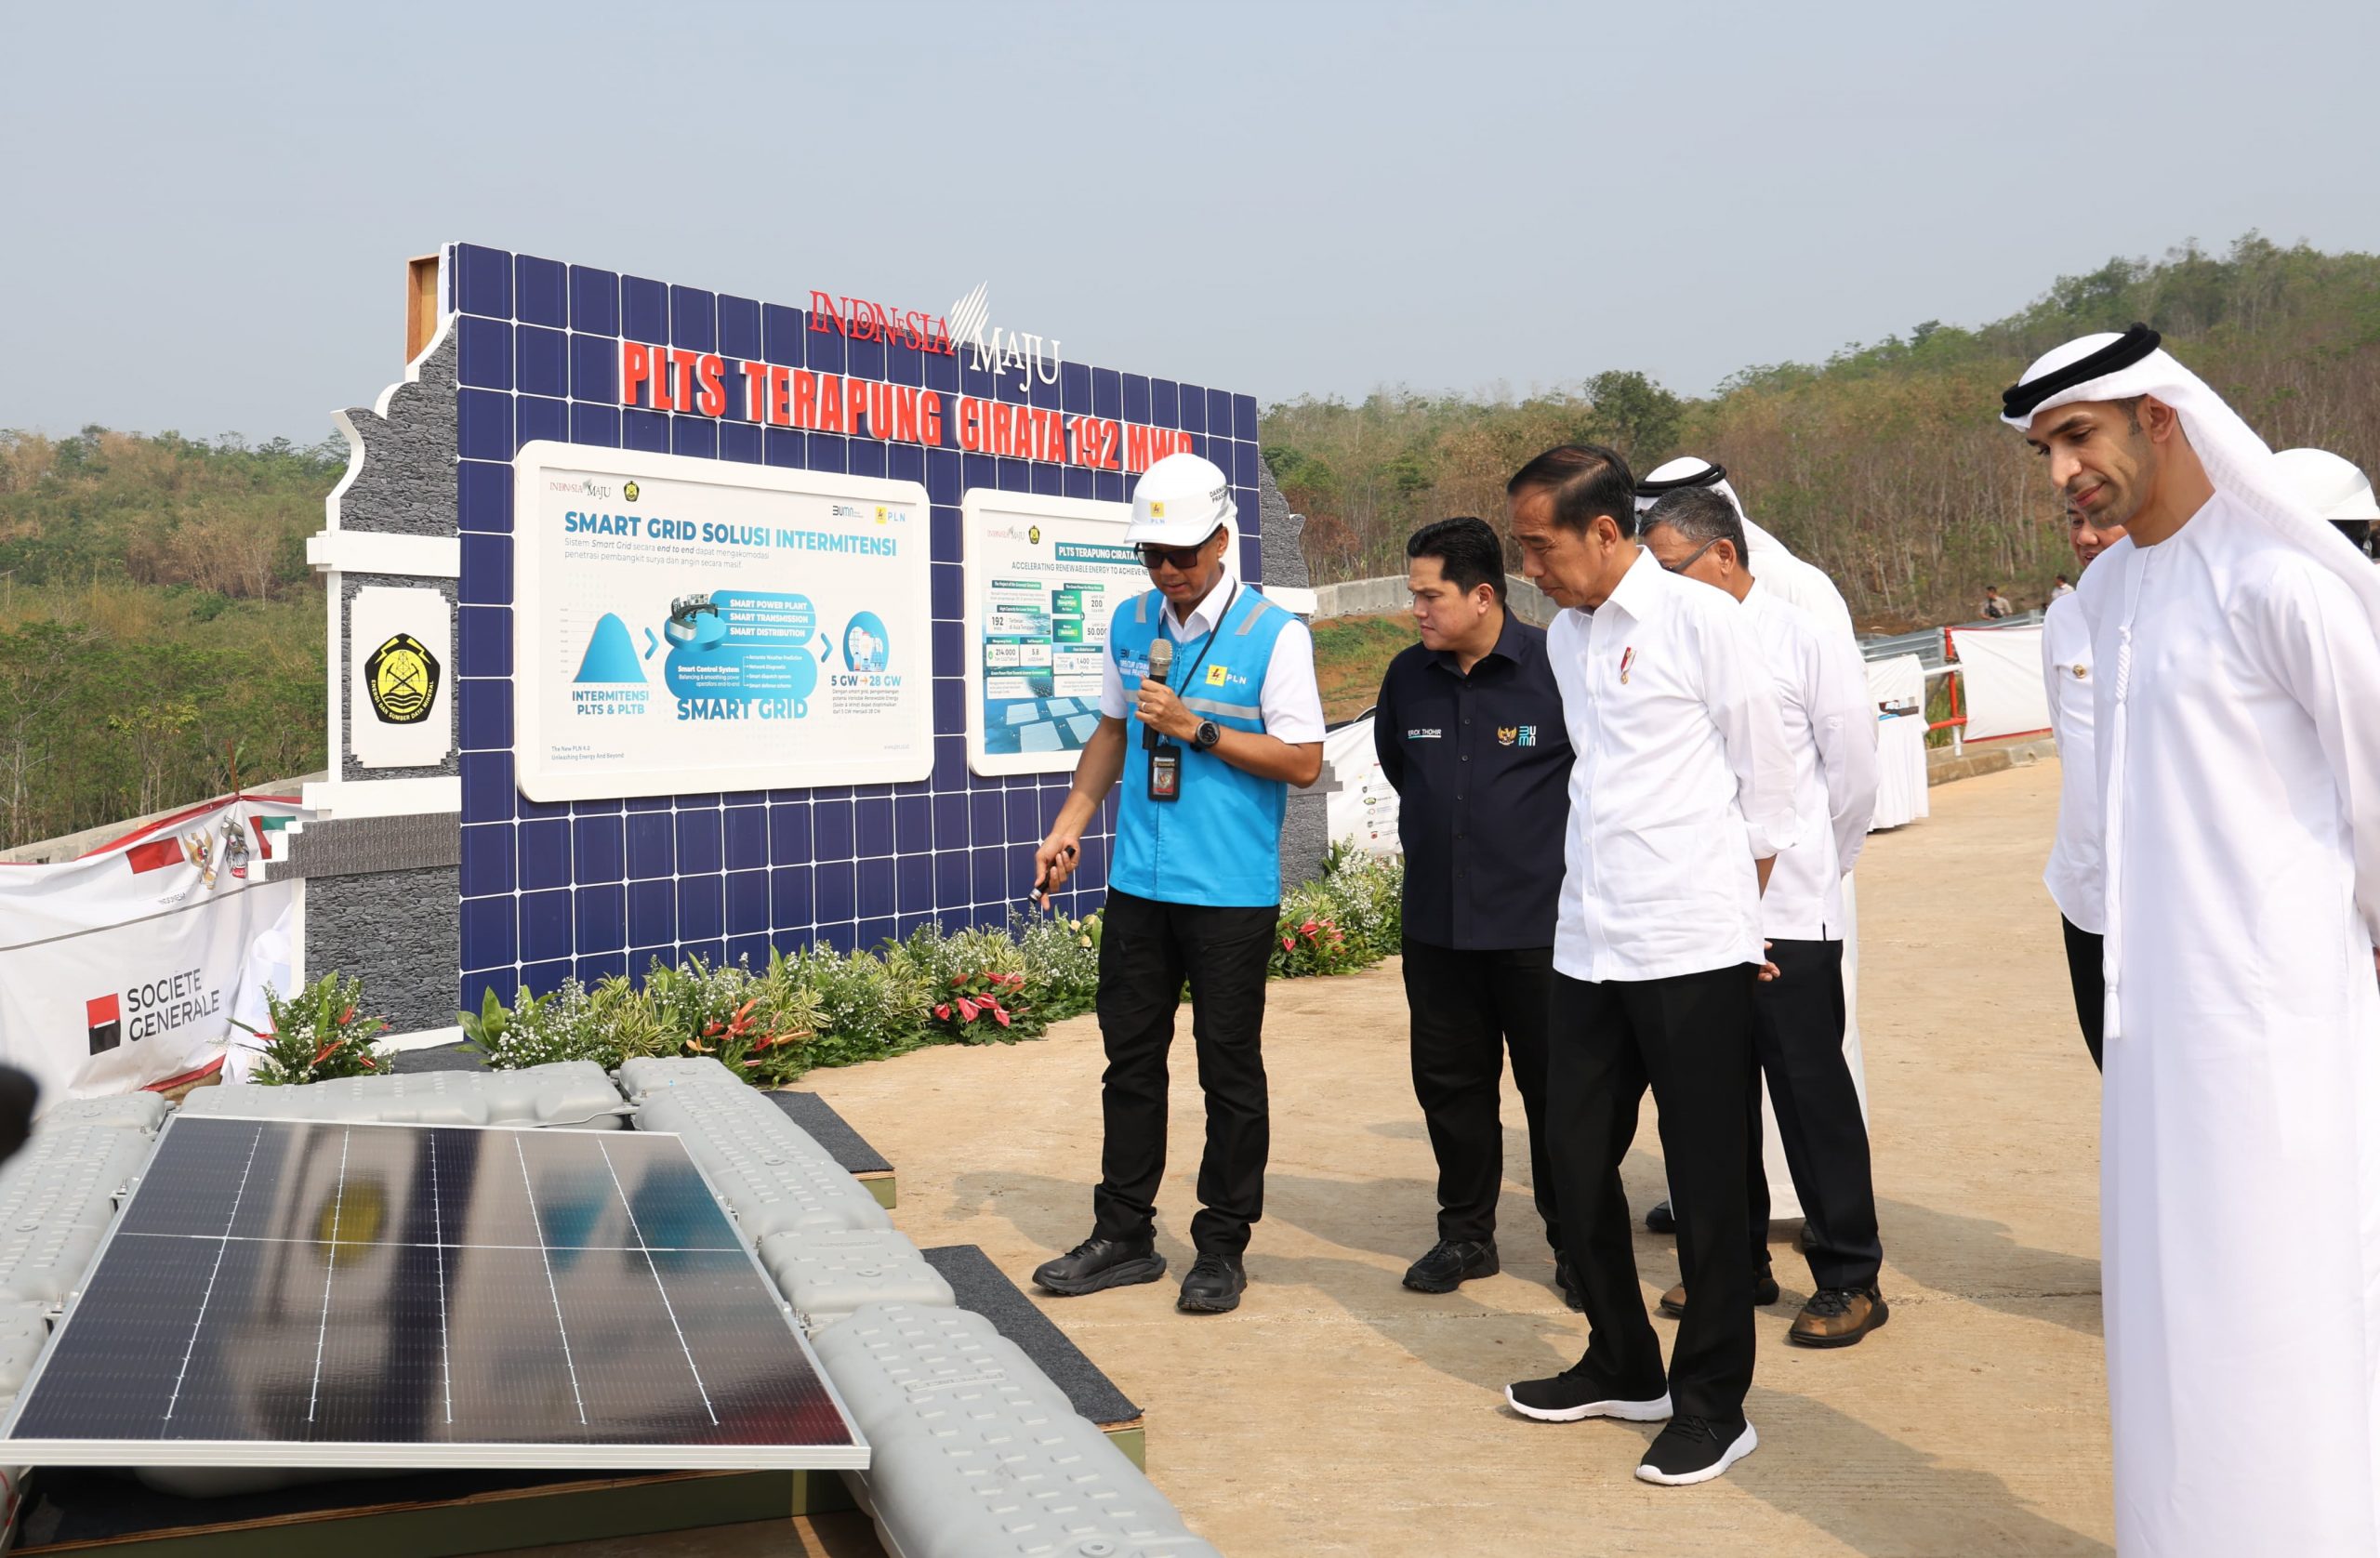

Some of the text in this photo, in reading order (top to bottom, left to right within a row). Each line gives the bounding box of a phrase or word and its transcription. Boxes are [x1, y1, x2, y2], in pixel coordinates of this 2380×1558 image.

[970, 326, 1062, 392] MAJU
[619, 340, 726, 417] PLTS
[740, 361, 942, 447] TERAPUNG
[955, 396, 1066, 463] CIRATA
[1066, 415, 1119, 469] 192
[887, 511, 906, 522] PLN
[564, 510, 897, 557] SMART GRID SOLUSI INTERMITENSI
[564, 537, 770, 560] Sistem Smart Grid secara end to end dapat mengakomodasi
[1058, 546, 1135, 561] PLTS TERAPUNG CIRATA
[564, 550, 600, 561] penetrasi
[601, 552, 645, 563] pembangkit
[646, 556, 665, 565] surya
[666, 555, 680, 564] dan
[681, 558, 700, 568] angin
[701, 560, 722, 568] secara
[1012, 561, 1055, 572] ACCELERATING
[1055, 563, 1089, 573] RENEWABLE
[1089, 564, 1110, 574] ENERGY
[1110, 566, 1117, 574] TO
[1118, 566, 1141, 576] ACHIEVE
[730, 599, 808, 611] SMART POWER PLANT
[1091, 600, 1103, 608] 200
[730, 613, 809, 624] SMART TRANSMISSION
[991, 616, 1004, 626] 192
[730, 627, 805, 638] SMART DISTRIBUTION
[996, 648, 1016, 656] 214.000
[678, 665, 696, 673] Smart
[719, 666, 740, 675] System
[831, 675, 902, 687] 5 GW 28 GW
[1226, 673, 1247, 684] PLN
[371, 679, 434, 721] ENERGI DAN SUMBER DAYA MINERAL
[572, 690, 650, 702] INTERMITENSI
[577, 704, 645, 715] PLTS & PLTB
[677, 698, 809, 720] SMART GRID
[127, 968, 202, 1012] SOCIETE
[129, 989, 219, 1042] GENERALE
